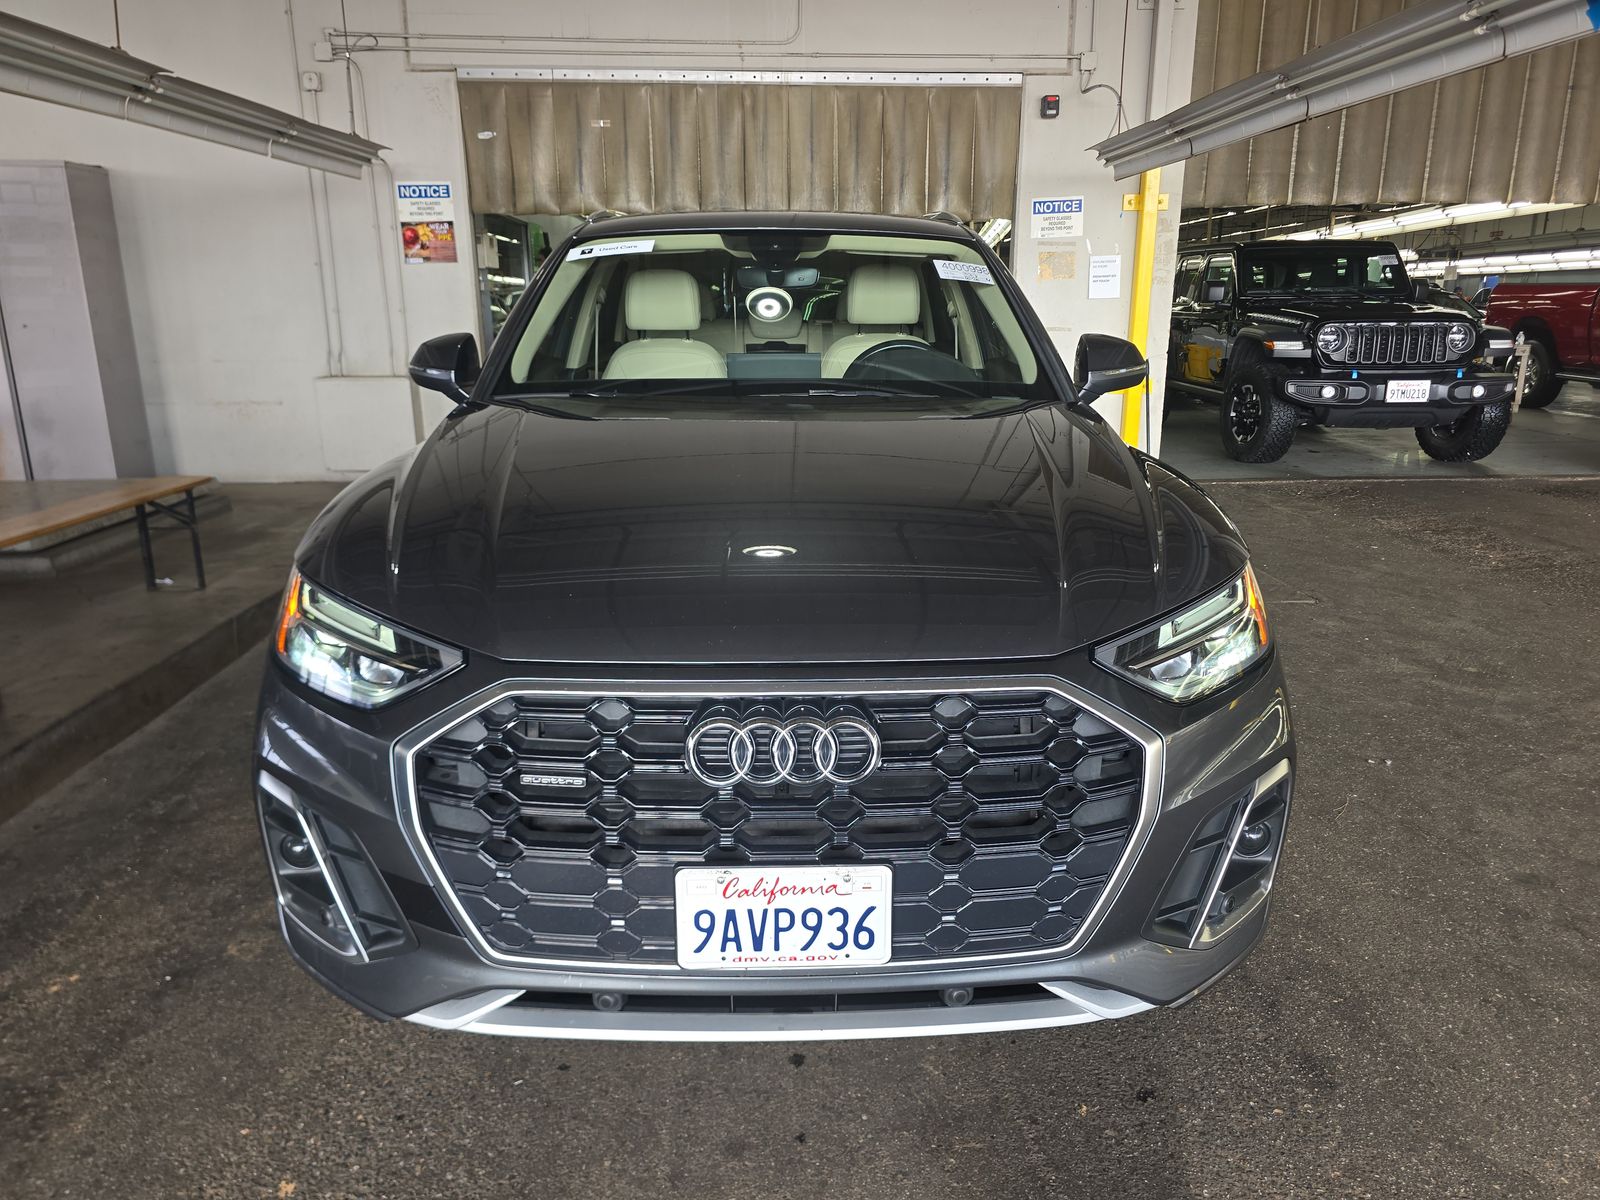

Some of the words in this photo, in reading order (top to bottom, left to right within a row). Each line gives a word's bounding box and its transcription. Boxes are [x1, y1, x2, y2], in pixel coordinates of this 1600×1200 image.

[400, 186, 448, 198] NOTICE
[1035, 200, 1080, 213] NOTICE
[1390, 388, 1427, 399] 9TMU218
[522, 776, 583, 785] quattro
[722, 876, 852, 905] California
[693, 906, 877, 953] 9AVP936
[732, 954, 839, 963] dmv.ca.gov
